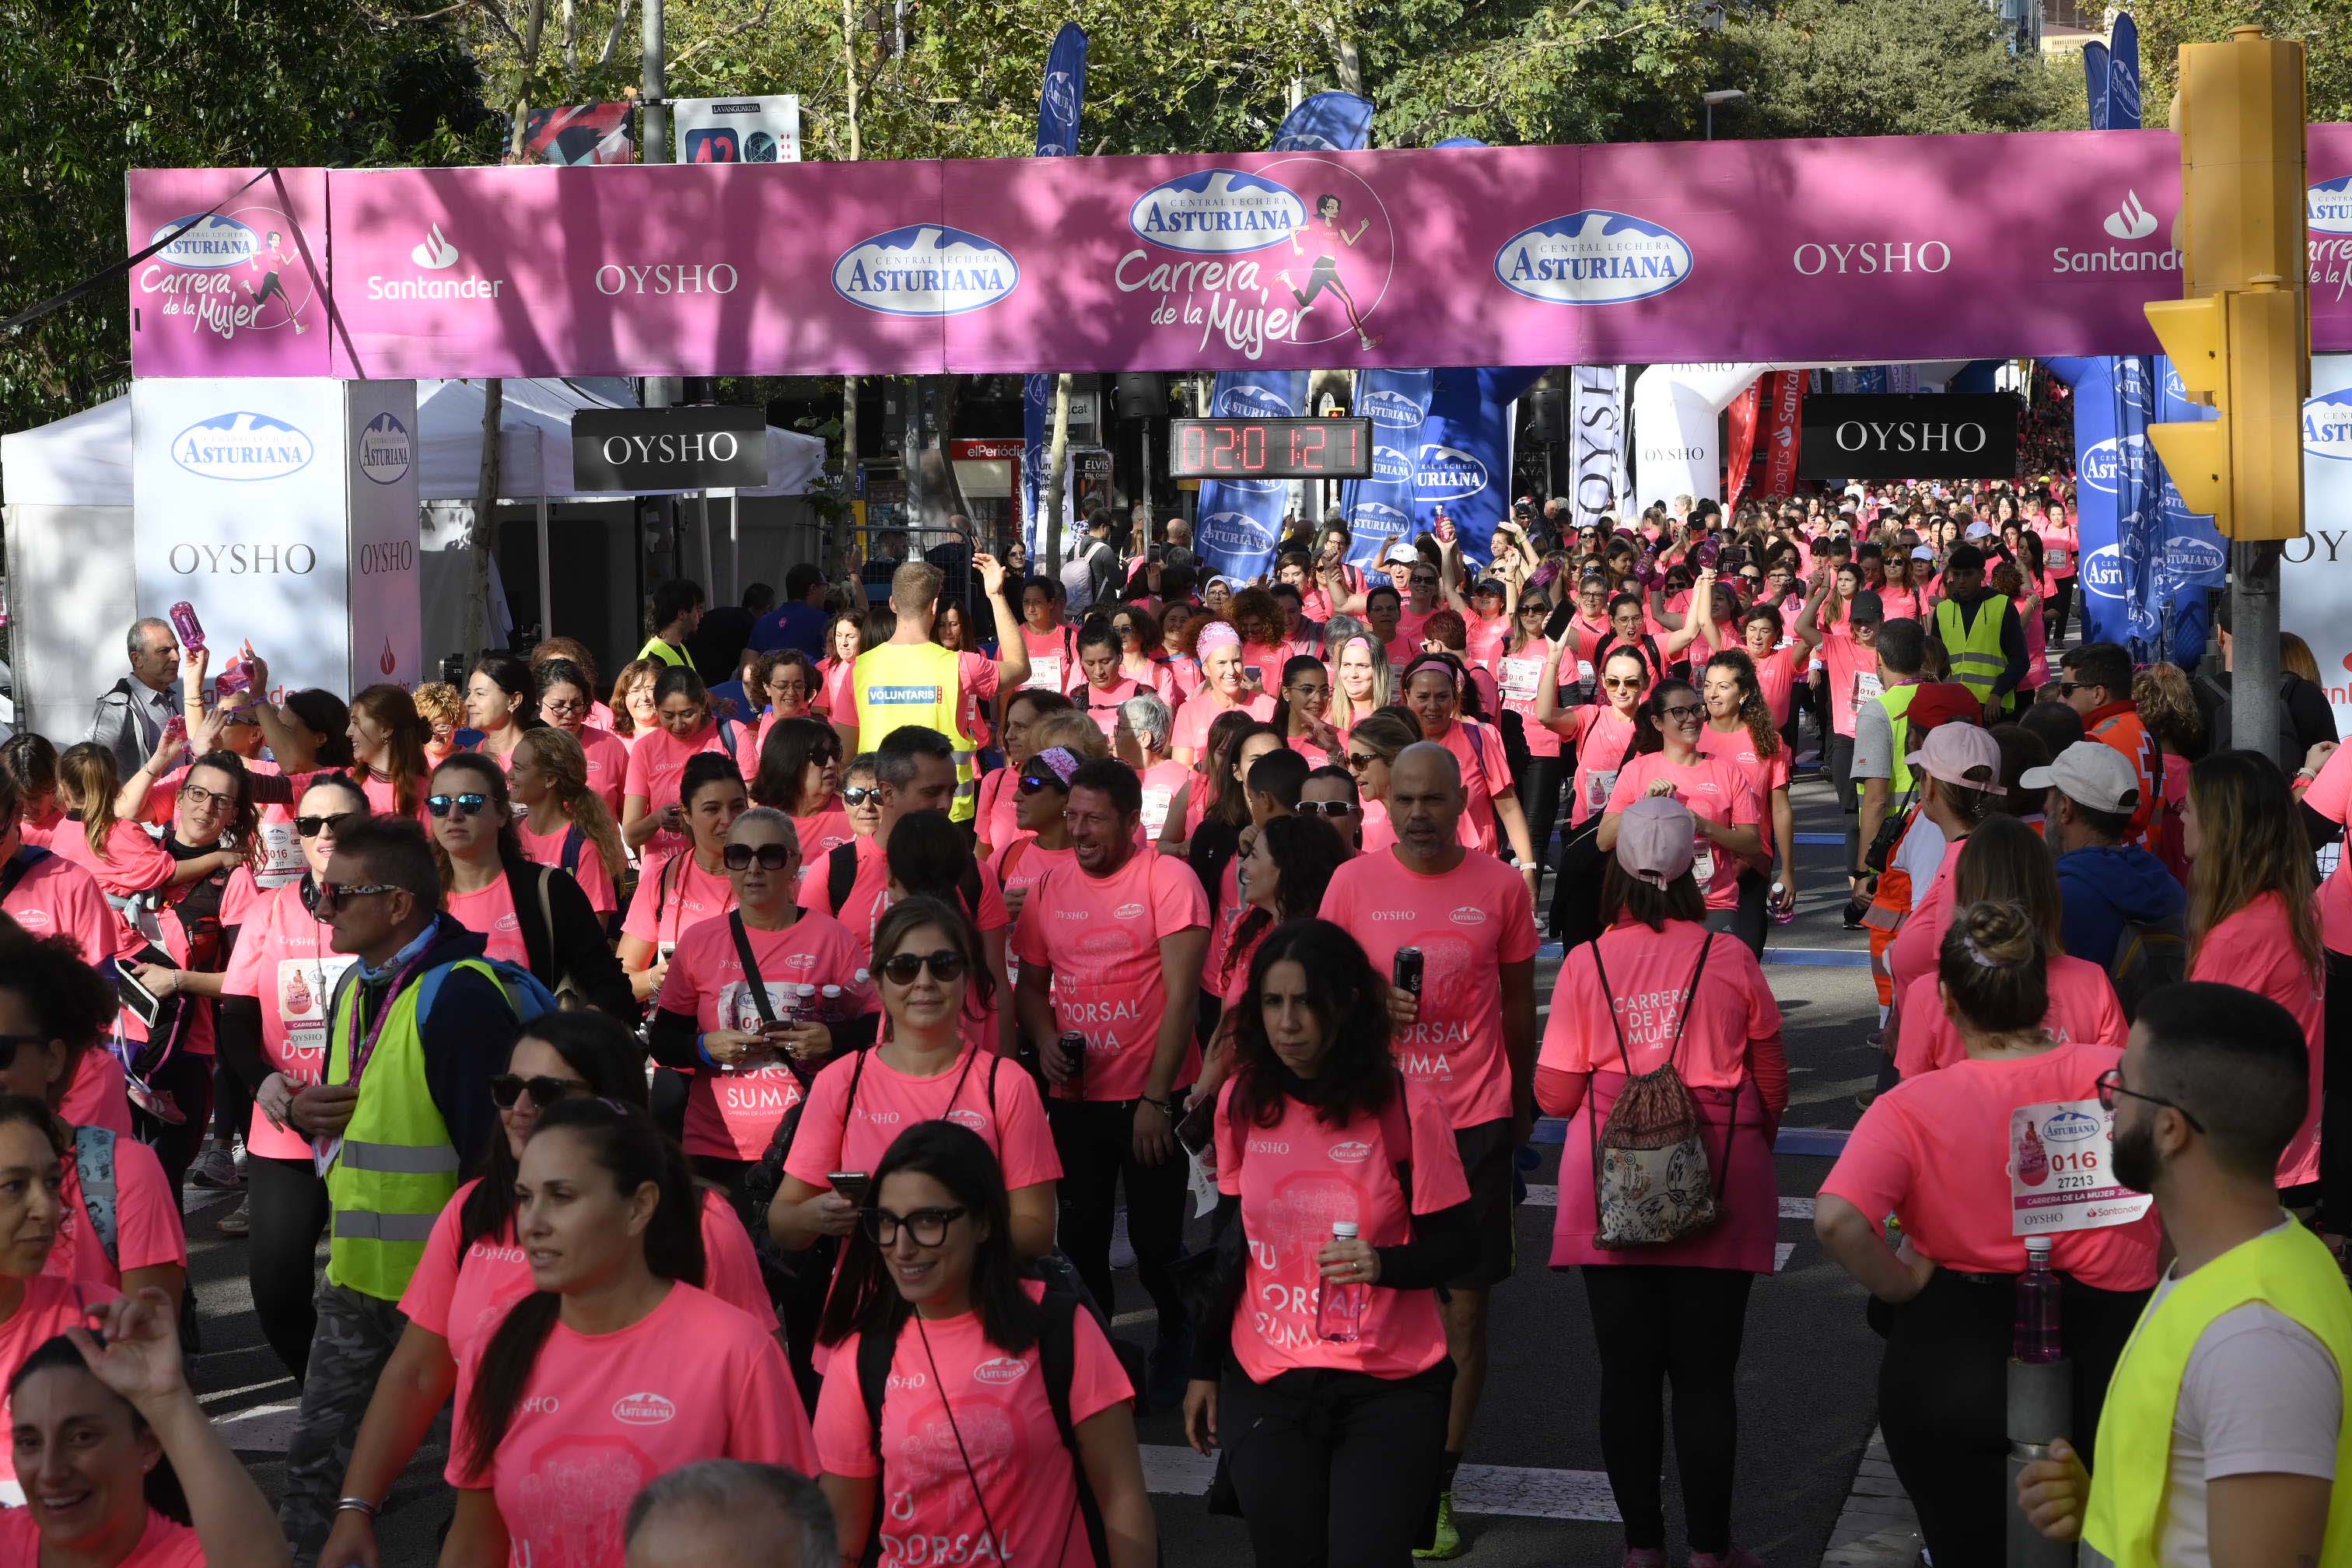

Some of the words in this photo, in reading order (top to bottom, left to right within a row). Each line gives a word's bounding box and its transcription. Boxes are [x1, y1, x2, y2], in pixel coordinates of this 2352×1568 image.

[721, 104, 760, 113] VANGUARDIA
[1171, 198, 1228, 208] CENTRAL
[1232, 197, 1288, 207] LECHERA
[1144, 201, 1292, 233] ASTURIANA
[159, 234, 250, 255] ASTURIANA
[1541, 243, 1601, 253] CENTRAL
[1608, 242, 1671, 251] LECHERA
[2308, 239, 2352, 262] arre
[875, 256, 933, 265] CENTRAL
[939, 255, 999, 264] LECHERA
[1510, 247, 1678, 282] ASTURIANA
[1793, 241, 1951, 275] OYSHO
[2053, 247, 2184, 274] Santand
[141, 264, 231, 294] Carrera
[596, 263, 738, 296] OYSHO
[847, 258, 1005, 293] ASTURIANA
[1115, 250, 1259, 292] Carrera
[2308, 263, 2322, 284] e
[2326, 262, 2339, 284] la
[368, 275, 503, 299] Santander
[163, 298, 180, 316] de
[183, 299, 195, 316] la
[194, 291, 265, 339] Mujer
[1151, 296, 1177, 325] de
[1183, 293, 1202, 325] la
[1199, 285, 1314, 360] Mujer
[1778, 369, 1801, 425] Santa
[1362, 399, 1418, 423] ASTURIANA
[2323, 411, 2352, 420] CENT
[1579, 366, 1615, 515] OYSH
[1836, 421, 1986, 453] OYSHO
[183, 438, 303, 464] ASTURIANA
[362, 440, 408, 467] ASTURIANA
[603, 432, 738, 465] OYSHO
[967, 443, 1024, 458] elPeriódi
[1183, 426, 1357, 471] 02:01:21
[1514, 452, 1545, 463] UGES
[1645, 446, 1704, 461] OYSHO
[1085, 460, 1108, 470] ELVIS
[1373, 463, 1409, 477] URIANA
[1518, 467, 1545, 476] NYA
[1776, 449, 1790, 502] ports
[1418, 474, 1481, 488] URIANA
[1352, 518, 1406, 534] STURIANA
[2283, 530, 2350, 563] OY
[170, 544, 317, 575] OYSHO
[360, 540, 412, 576] OYSHO
[2165, 553, 2217, 567] STURIANA
[870, 690, 935, 700] VOLUNTARIS
[1860, 688, 1877, 697] 016
[1503, 702, 1536, 716] ORSAL
[655, 762, 682, 772] OYSHO
[270, 849, 288, 859] 016
[1371, 909, 1416, 922] OYSHO
[1451, 912, 1485, 922] ASTURIANA
[1612, 987, 1694, 1014] CARRERA
[742, 1017, 763, 1030] 01
[1629, 1011, 1651, 1028] DE
[1661, 1006, 1681, 1025] LA
[292, 1032, 322, 1042] OYSHO
[1085, 1030, 1121, 1051] MA
[1402, 1020, 1470, 1044] RSAL
[1627, 1023, 1685, 1045] MUJER
[1401, 1052, 1451, 1074] MA
[726, 1083, 801, 1108] SUMA
[857, 1107, 900, 1125] SHO
[950, 1117, 983, 1128] URIANA
[2047, 1124, 2096, 1136] ASTURIANA
[2052, 1151, 2098, 1172] 016
[2058, 1175, 2095, 1188] 27213
[2027, 1196, 2062, 1206] CARRERA
[2087, 1189, 2116, 1200] MUJER
[2024, 1212, 2063, 1227] OYSHO
[2098, 1205, 2141, 1217] Santander
[1262, 1283, 1367, 1318] ORSAL
[1254, 1311, 1324, 1350] SUM
[887, 1373, 926, 1391] SHO
[618, 1403, 670, 1418] ASTURIANA
[891, 1491, 915, 1521] U
[880, 1528, 1014, 1566] DORSAL
